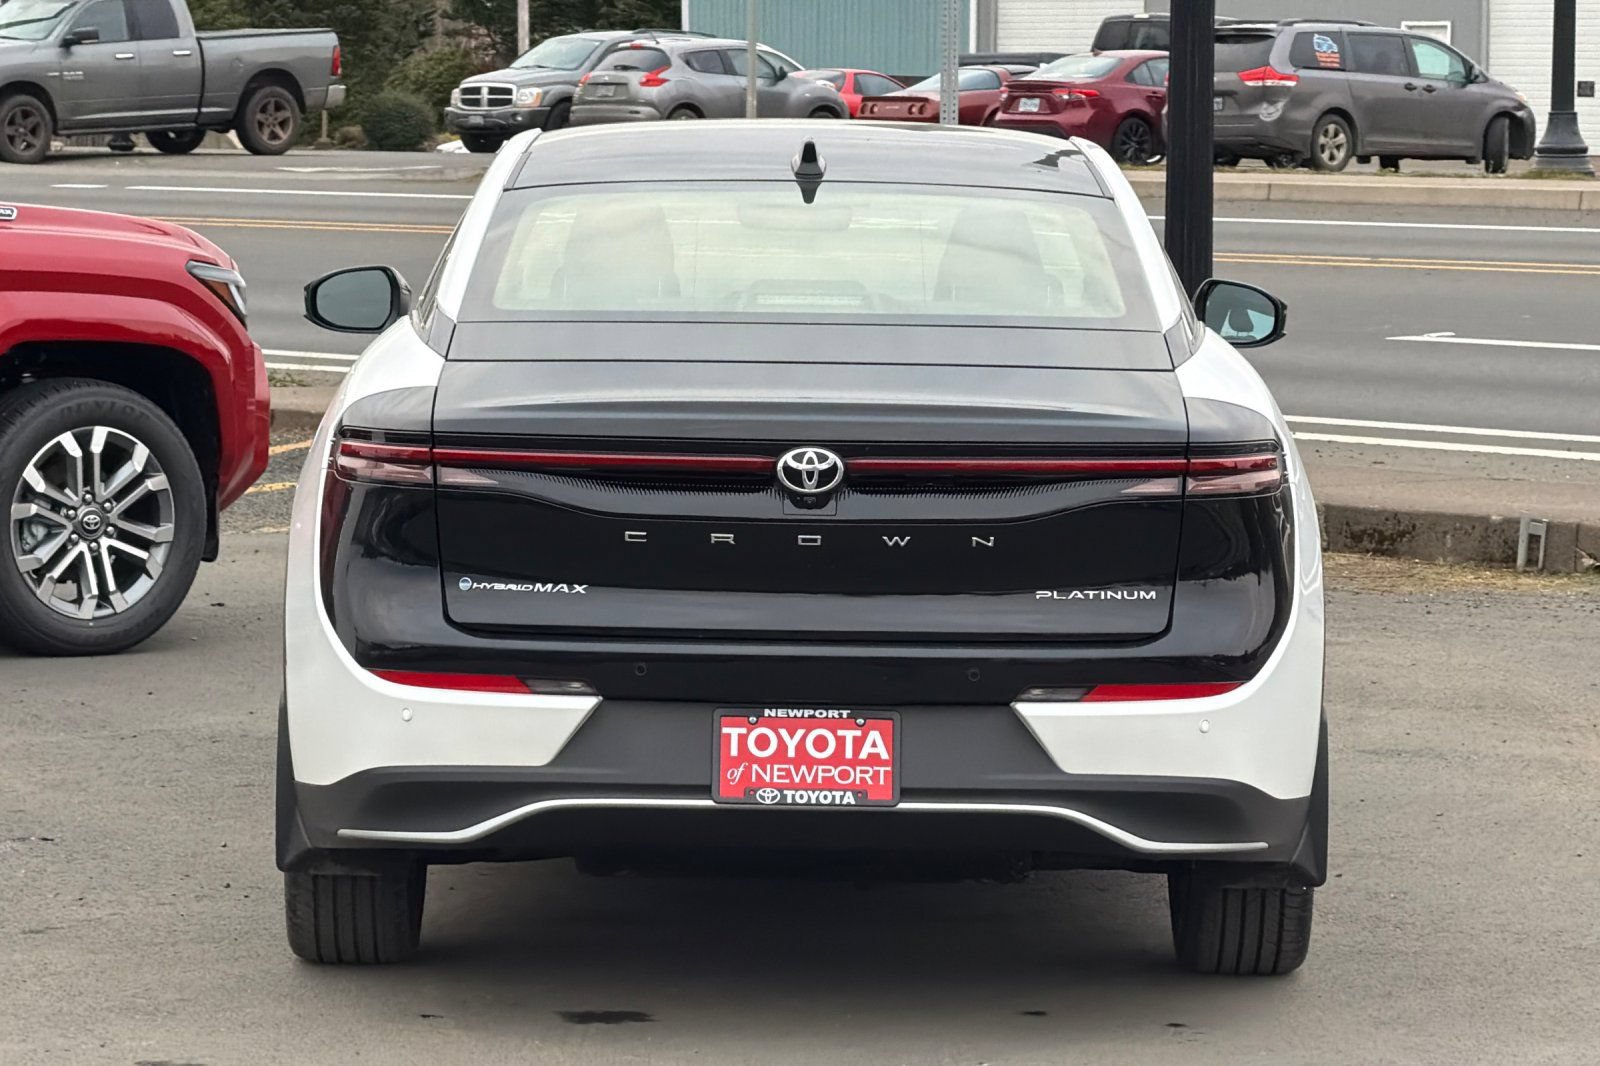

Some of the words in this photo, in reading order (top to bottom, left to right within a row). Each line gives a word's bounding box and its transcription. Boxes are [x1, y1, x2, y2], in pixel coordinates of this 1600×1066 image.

[624, 531, 995, 548] CROWN
[1035, 590, 1156, 600] PLATINUM
[764, 708, 851, 719] NEWPORT
[722, 727, 889, 759] TOYOTA
[727, 762, 748, 785] of
[751, 764, 891, 785] NEWPORT
[783, 790, 856, 805] TOYOTA
